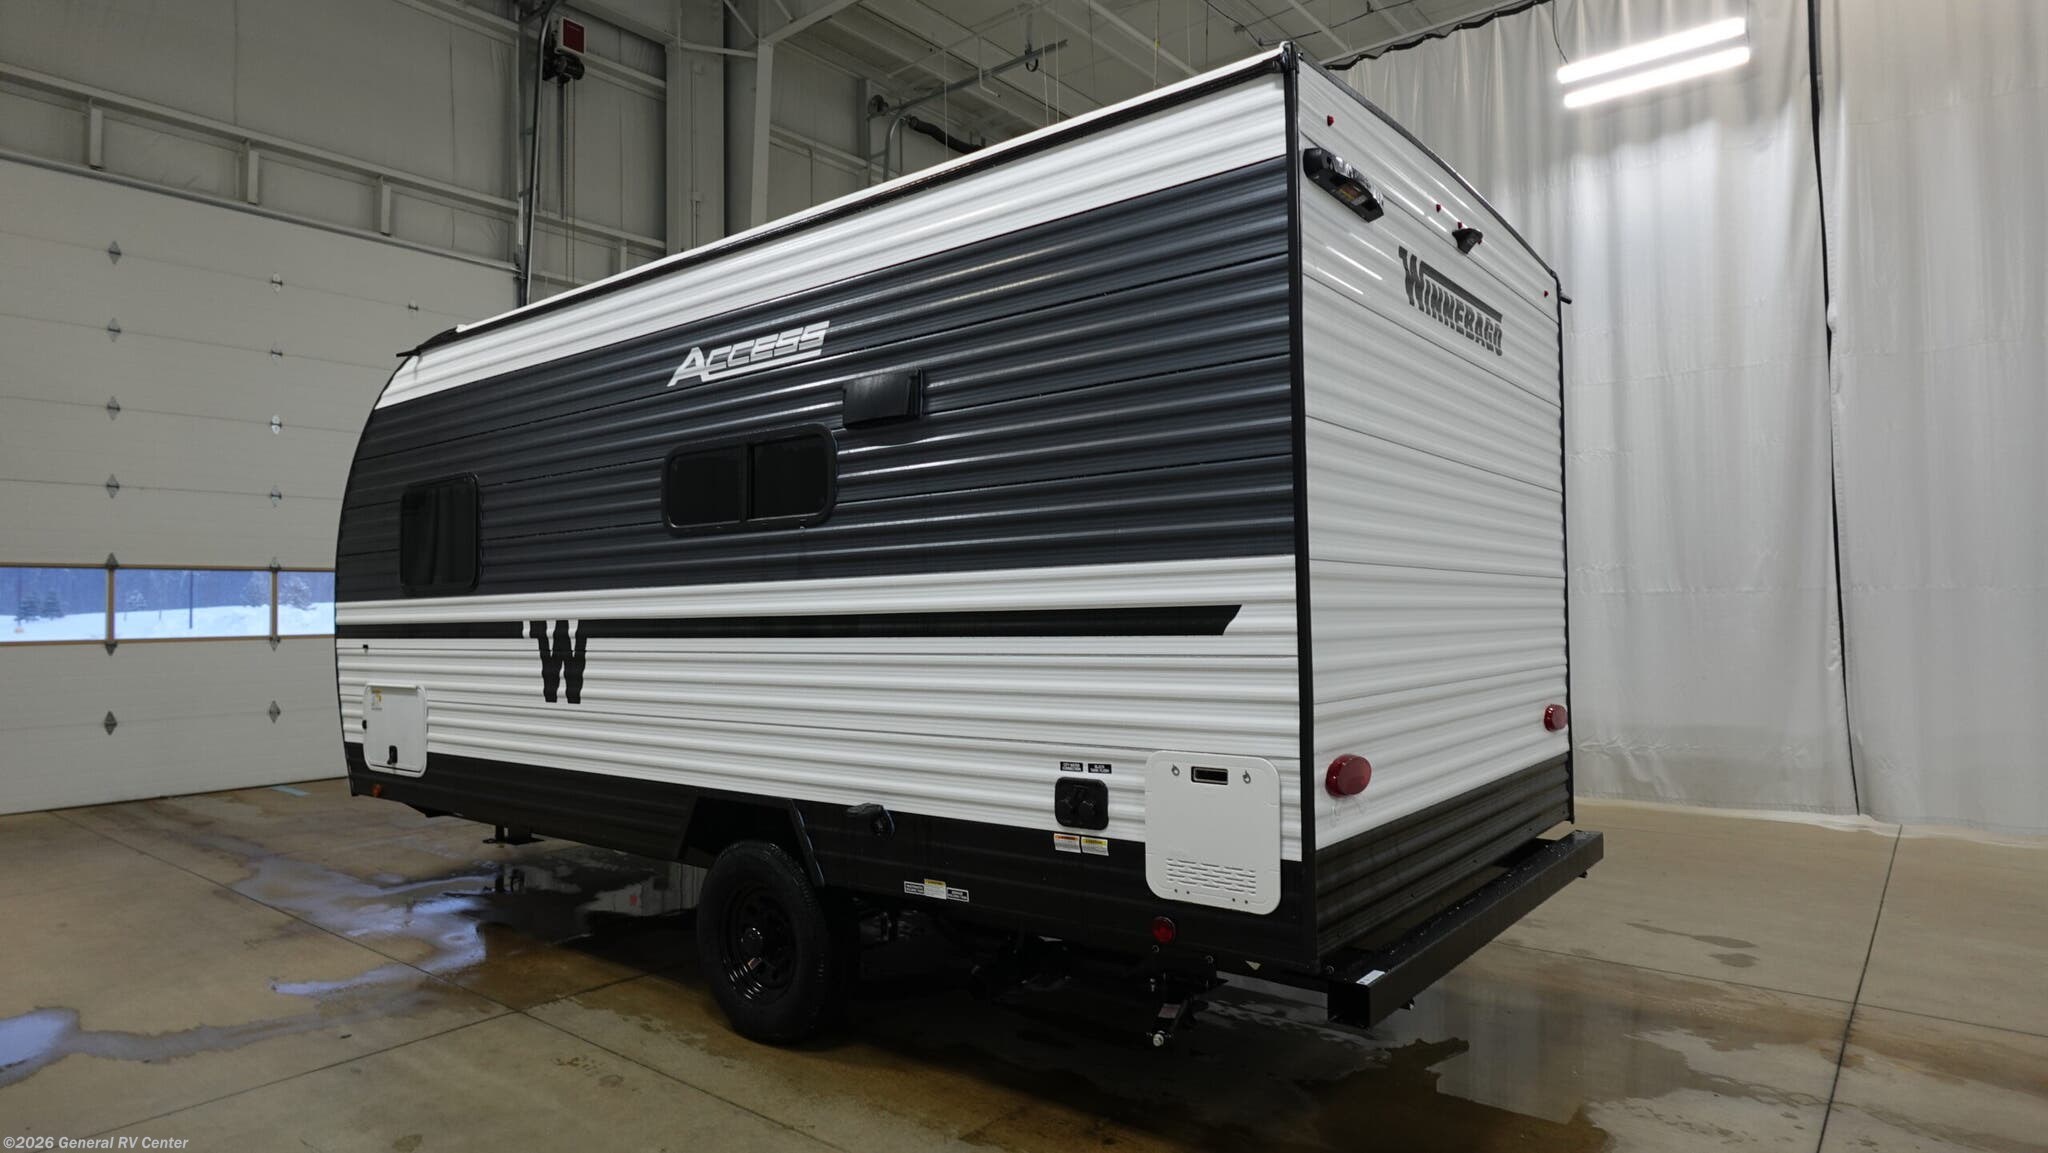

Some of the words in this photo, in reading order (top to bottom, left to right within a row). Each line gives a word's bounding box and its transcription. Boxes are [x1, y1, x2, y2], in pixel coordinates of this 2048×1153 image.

[1399, 245, 1503, 356] WINNEBAGO
[667, 320, 830, 387] ACCESS
[530, 620, 587, 704] W
